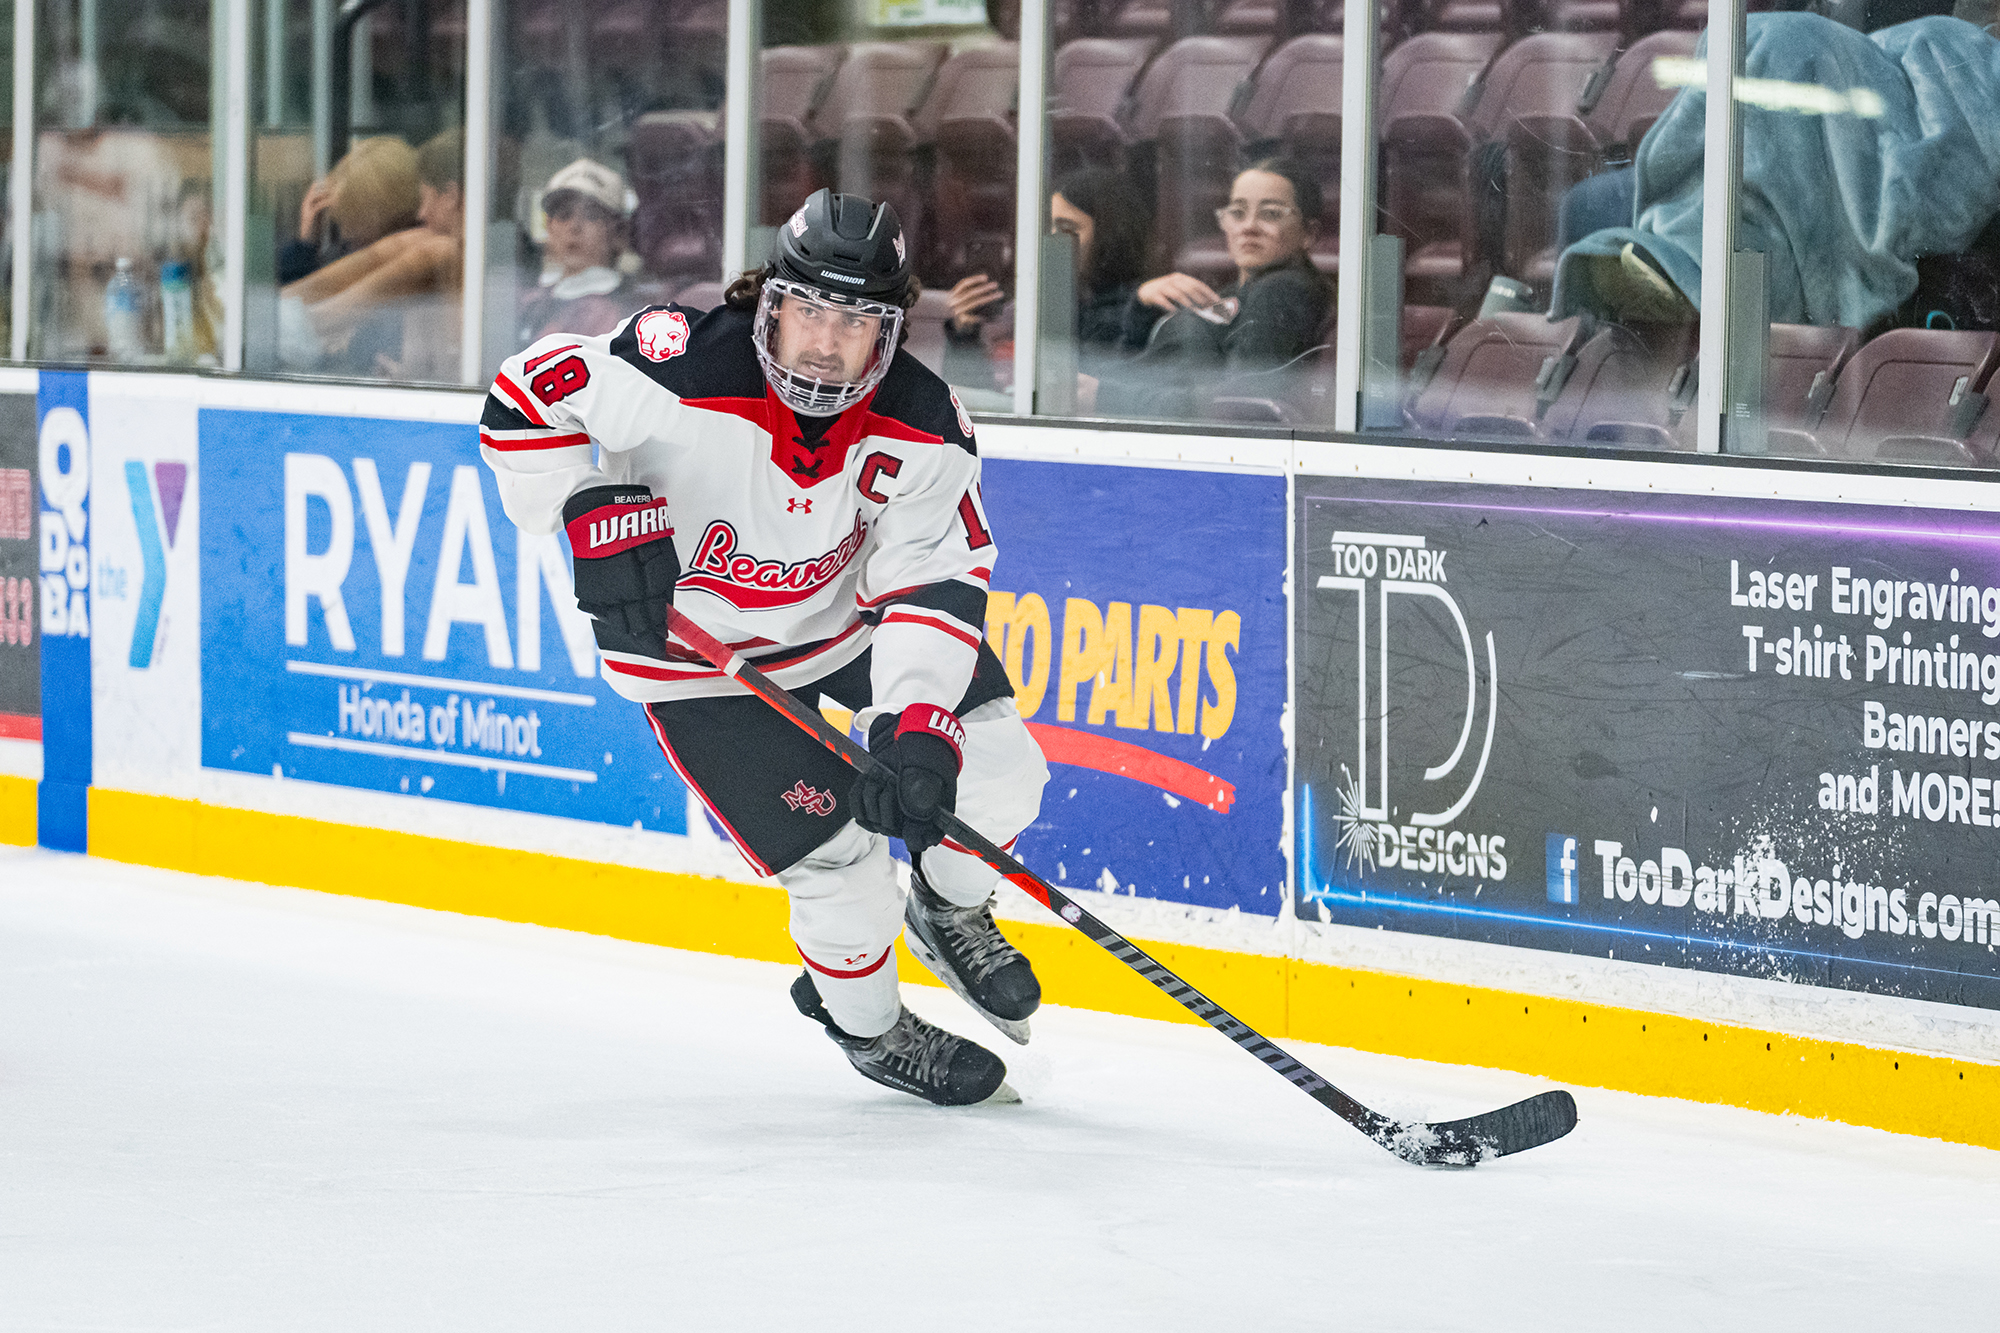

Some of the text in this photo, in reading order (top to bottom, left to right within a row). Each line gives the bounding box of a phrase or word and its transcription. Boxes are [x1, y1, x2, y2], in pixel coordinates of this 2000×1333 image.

[820, 269, 867, 286] WARRIOR
[523, 344, 591, 407] 18
[614, 495, 652, 504] BEAVERS
[857, 451, 903, 504] C
[957, 482, 993, 551] 1
[285, 452, 596, 678] RYAN
[1331, 544, 1448, 582] TOO DARK
[1731, 559, 2000, 638] Laser Engraving
[1057, 597, 1241, 739] PARTS
[1742, 624, 2000, 706] T-shirt Printing
[338, 684, 542, 758] Honda of Minot
[1864, 700, 2000, 761] Banners
[780, 779, 837, 817] MSU
[1818, 764, 2000, 829] and MORE!
[1378, 822, 1508, 881] DESIGNS
[1594, 839, 2000, 946] TooDarkDesigns.com
